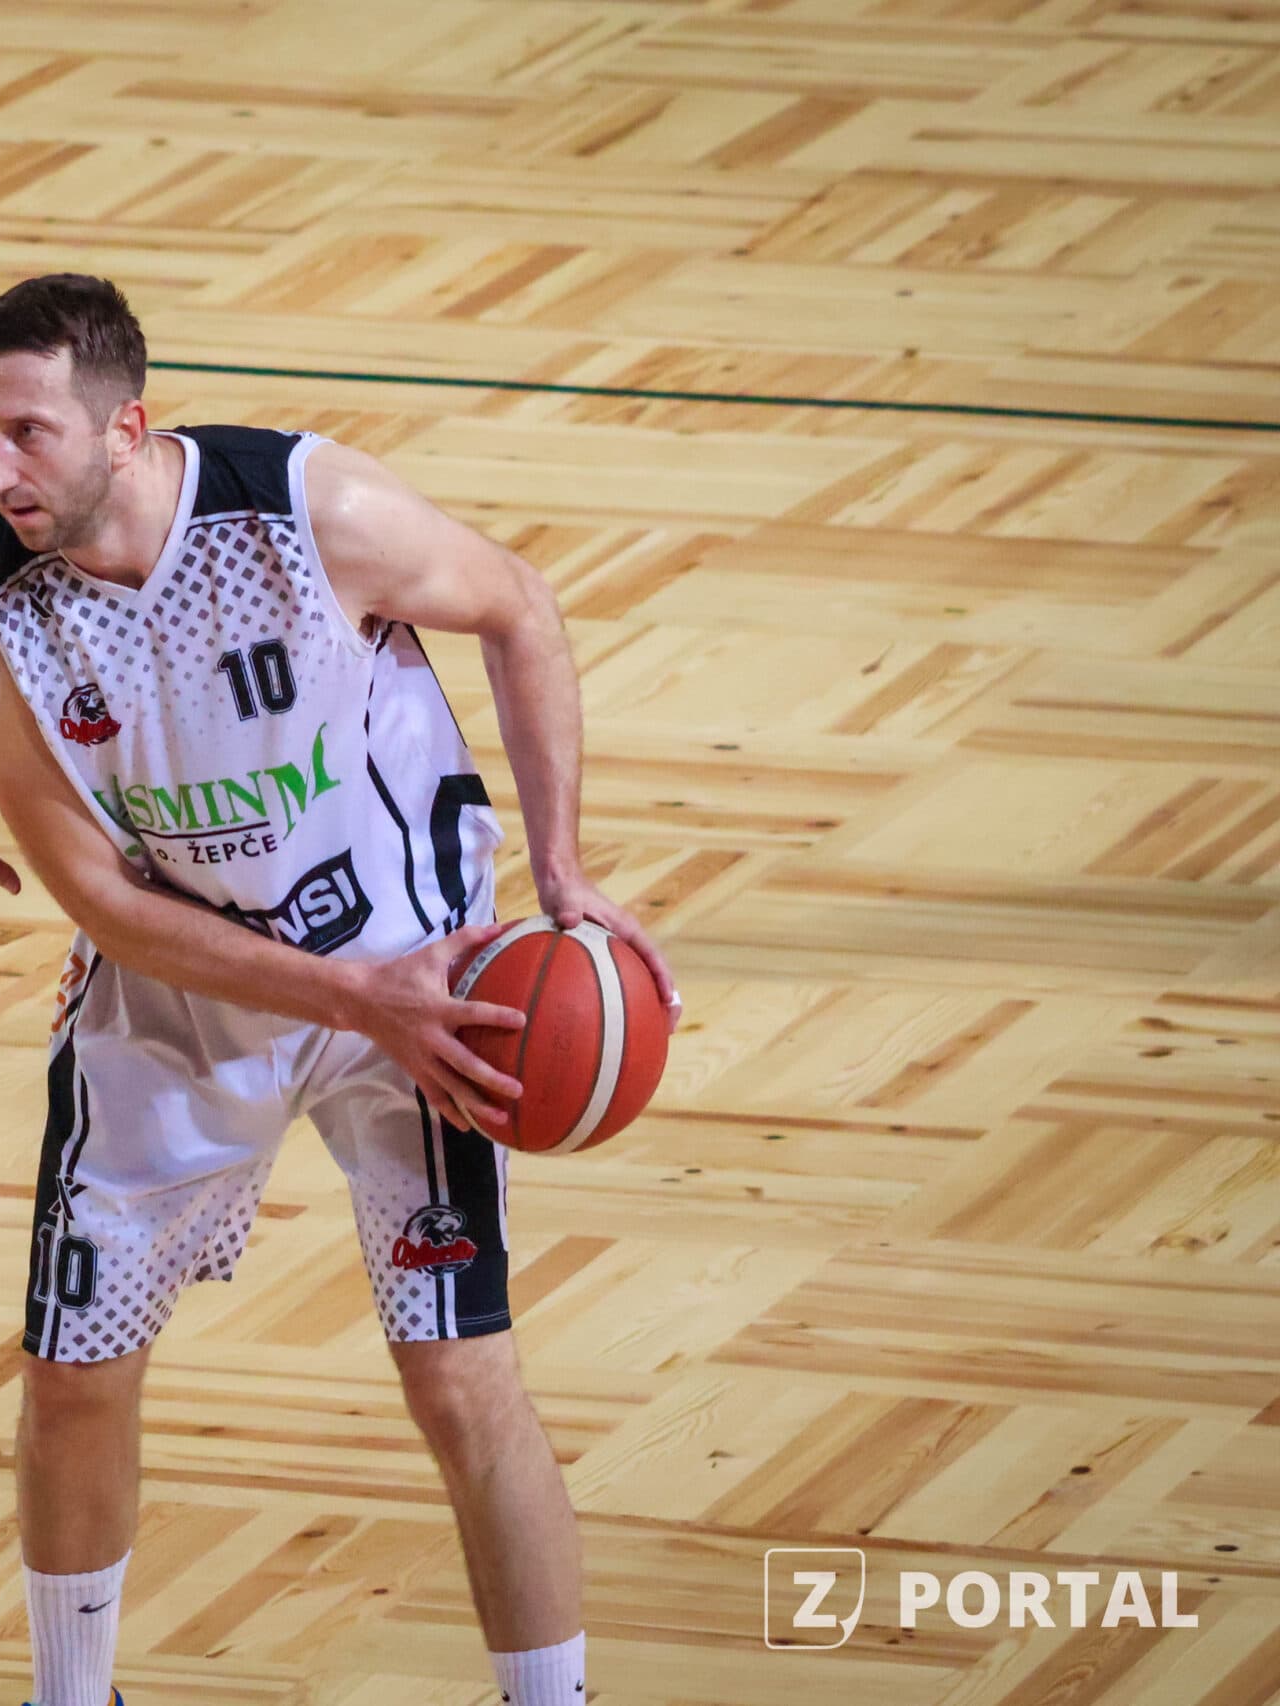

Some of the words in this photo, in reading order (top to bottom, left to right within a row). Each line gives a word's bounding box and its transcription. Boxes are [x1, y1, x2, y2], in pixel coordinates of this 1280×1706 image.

[217, 638, 298, 721] 10
[187, 832, 278, 864] ŽEPČE
[33, 1222, 99, 1311] 10
